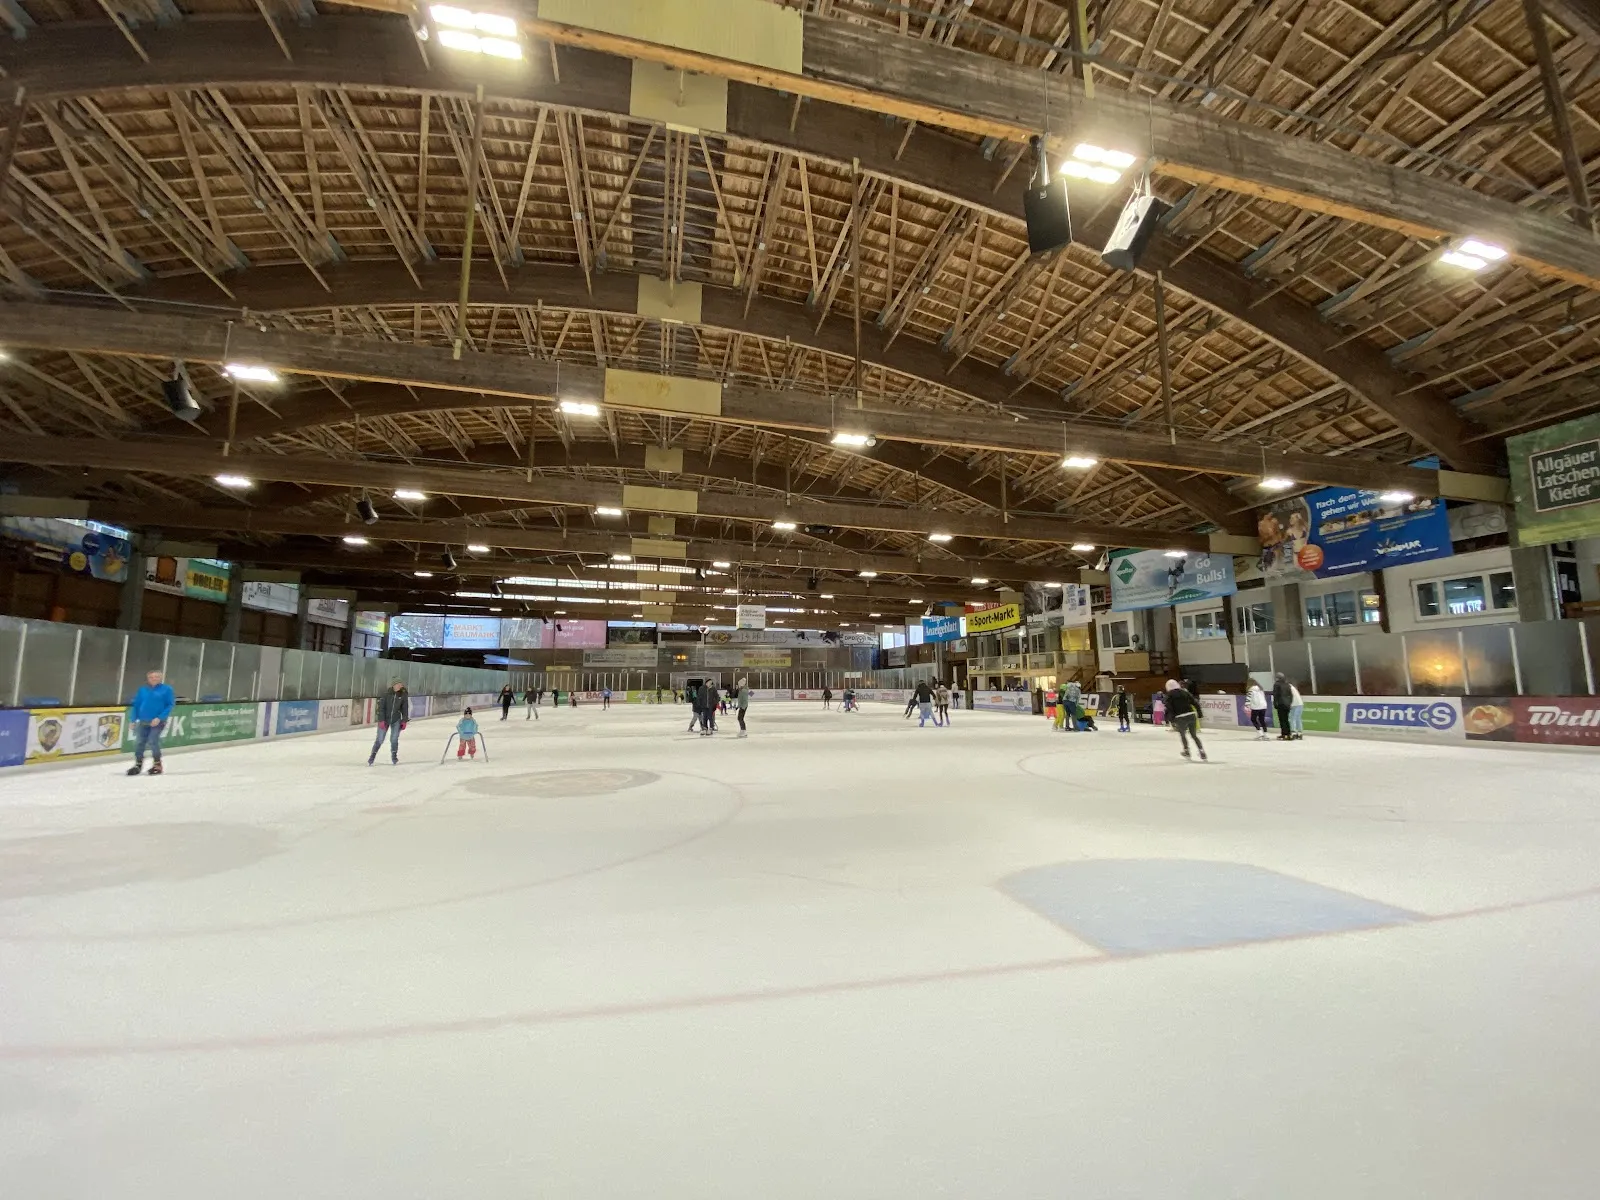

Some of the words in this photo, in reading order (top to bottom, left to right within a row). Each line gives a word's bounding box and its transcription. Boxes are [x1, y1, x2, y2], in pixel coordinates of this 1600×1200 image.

[1536, 450, 1597, 474] Allgäuer
[1537, 466, 1600, 490] Latschen
[1316, 498, 1336, 510] Nach
[1338, 493, 1357, 503] dem
[1549, 483, 1592, 503] Kiefer
[1321, 506, 1346, 519] gehen
[1347, 501, 1359, 510] wir
[1195, 557, 1210, 569] Go
[1196, 567, 1226, 585] Bulls!
[974, 607, 1015, 627] Sport-Markt
[1352, 705, 1416, 727] point
[1430, 706, 1453, 725] S
